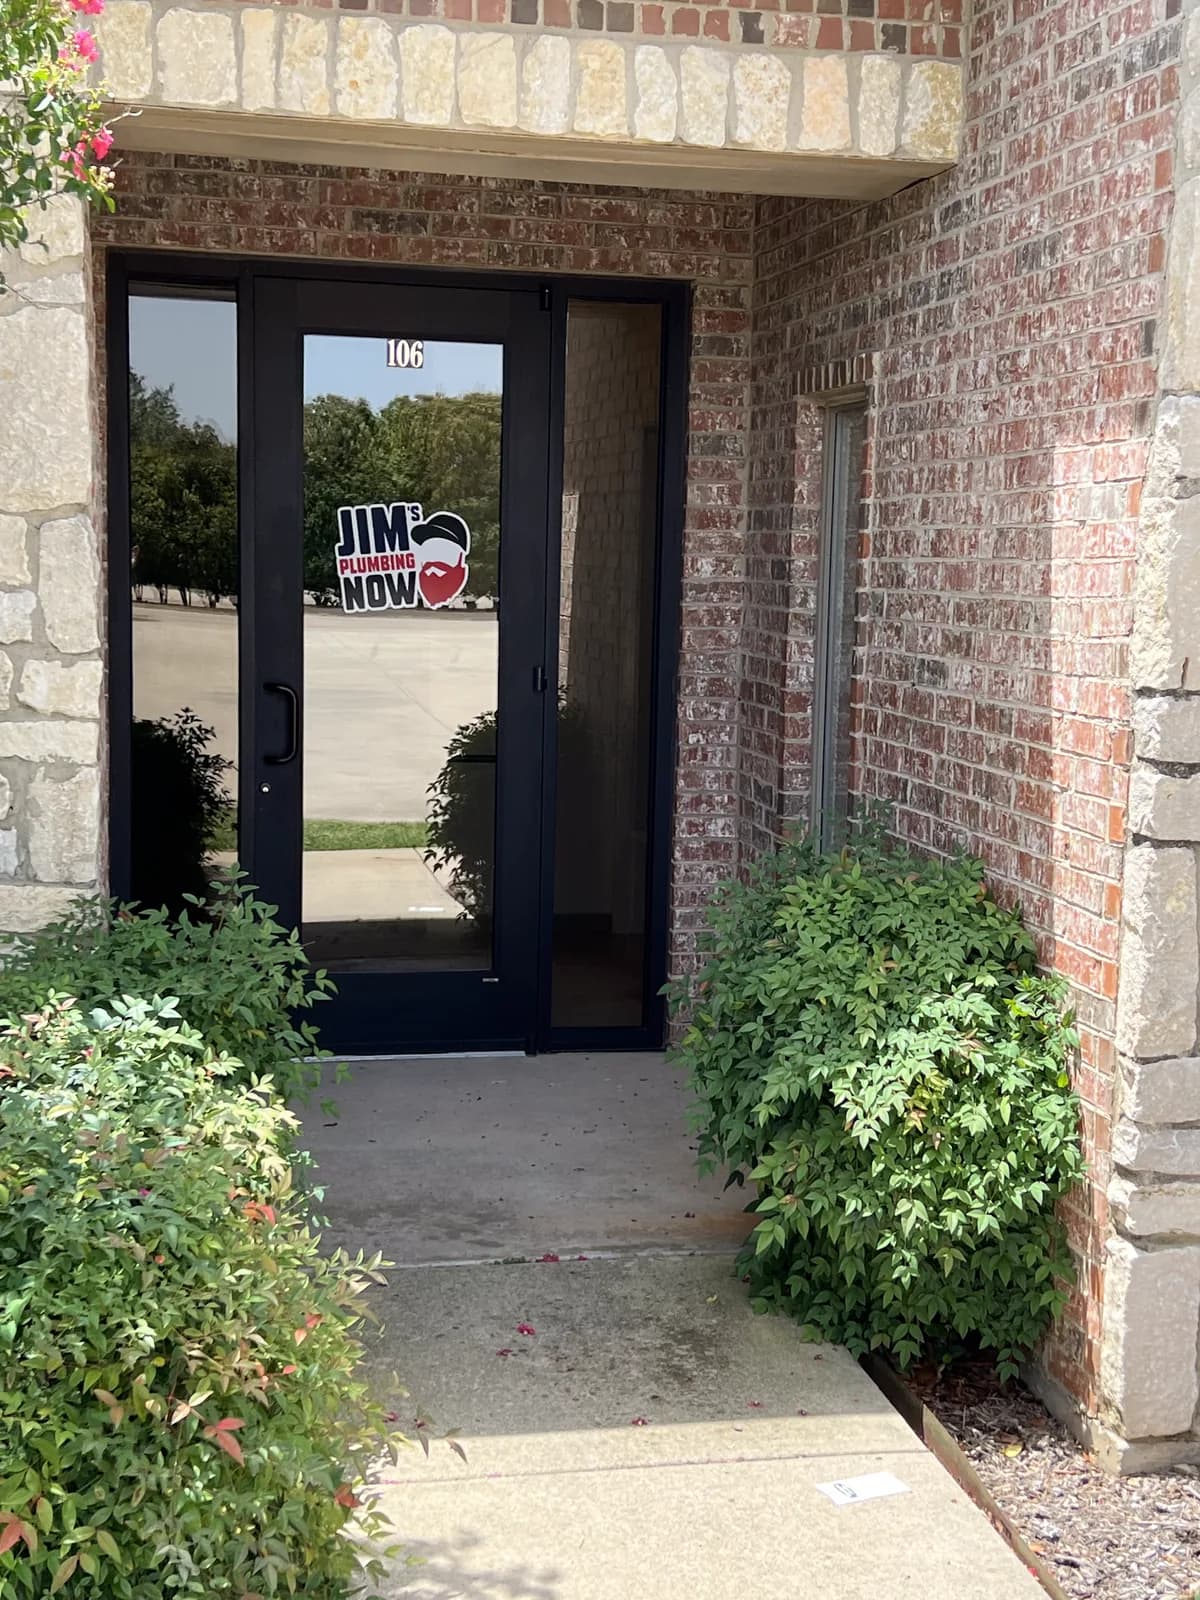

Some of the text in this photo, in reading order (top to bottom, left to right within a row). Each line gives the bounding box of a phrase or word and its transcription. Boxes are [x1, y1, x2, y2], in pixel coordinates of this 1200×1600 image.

[387, 338, 423, 368] 106
[337, 504, 420, 557] JIM'S
[339, 553, 416, 575] PLUMBING
[343, 571, 417, 611] NOW
